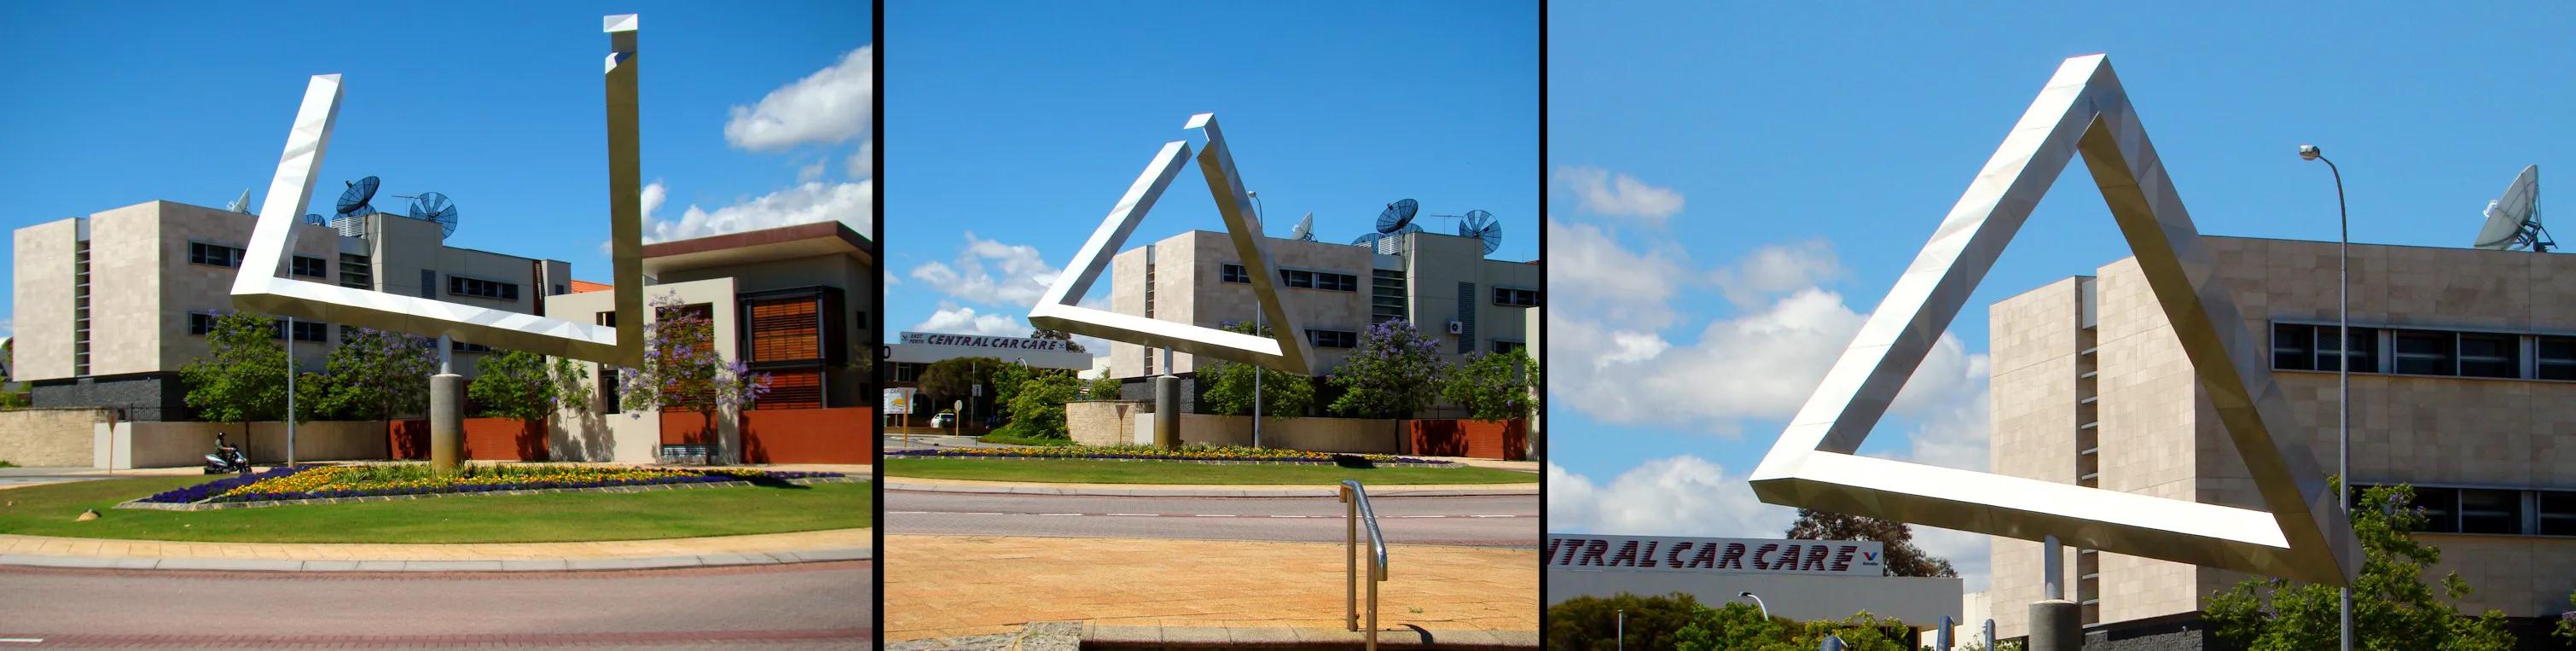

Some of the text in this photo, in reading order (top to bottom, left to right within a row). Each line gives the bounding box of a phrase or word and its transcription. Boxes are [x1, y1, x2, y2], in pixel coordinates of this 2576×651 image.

[928, 334, 1057, 350] CENTRAL CAR CARE
[1665, 542, 1747, 569] CAR
[1751, 543, 1849, 570] CARE
